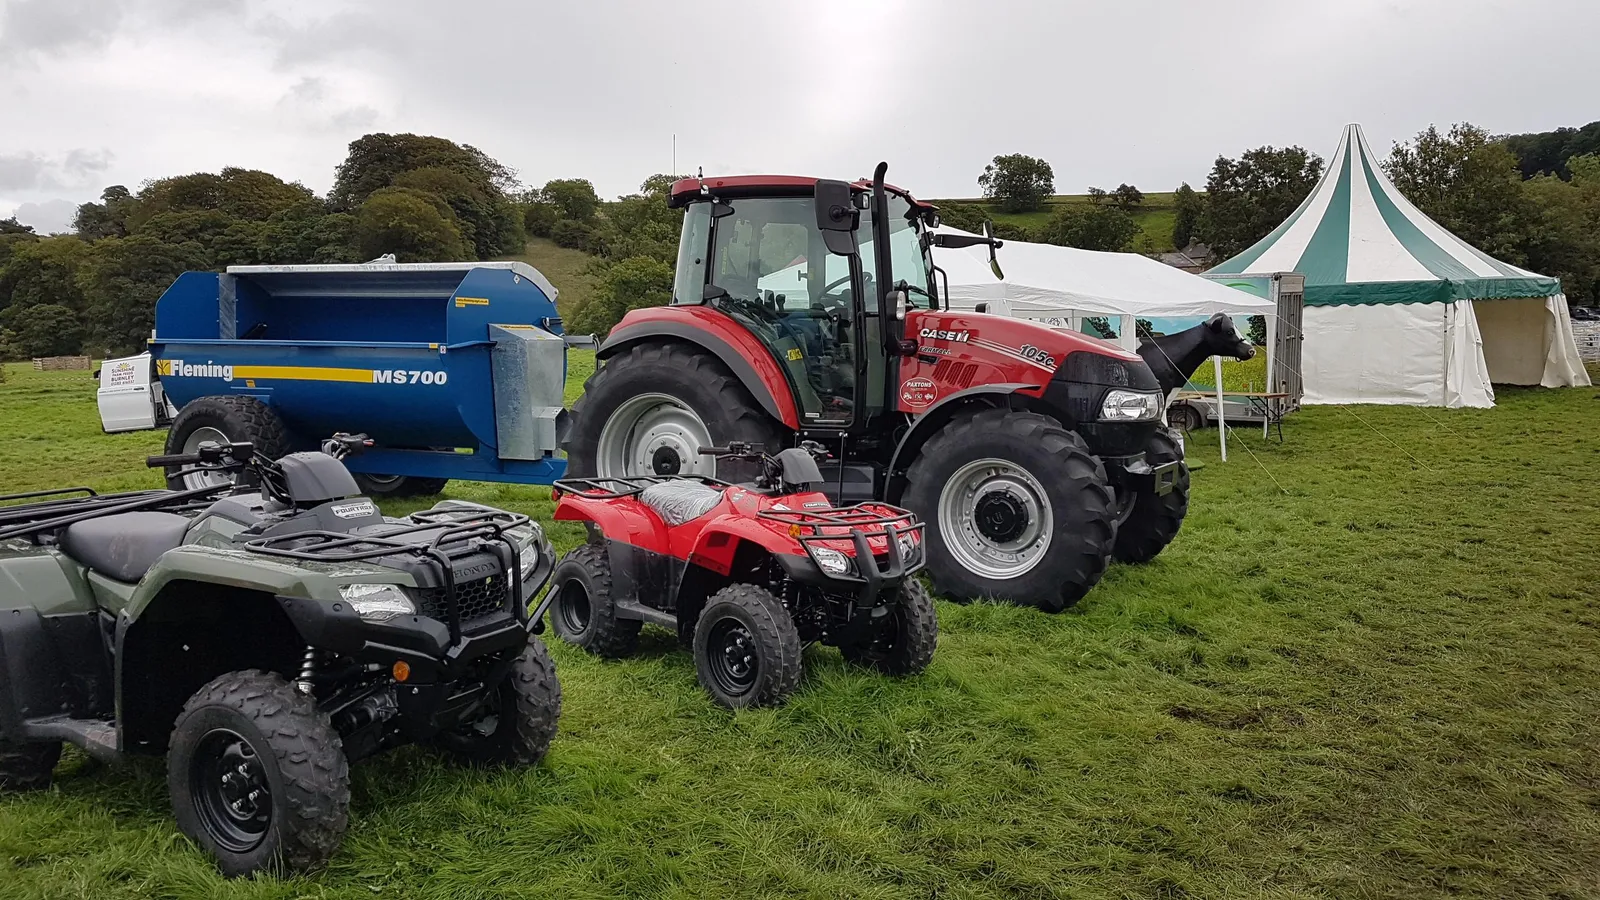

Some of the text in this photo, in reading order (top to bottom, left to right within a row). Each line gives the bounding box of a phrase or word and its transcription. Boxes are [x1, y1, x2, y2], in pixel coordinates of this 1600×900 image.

[920, 328, 956, 341] CASE
[111, 366, 135, 374] SUNSHINE
[170, 359, 233, 382] Fleming
[372, 369, 448, 385] MS700
[335, 505, 373, 515] FOURTRAX
[453, 562, 496, 578] HONDA
